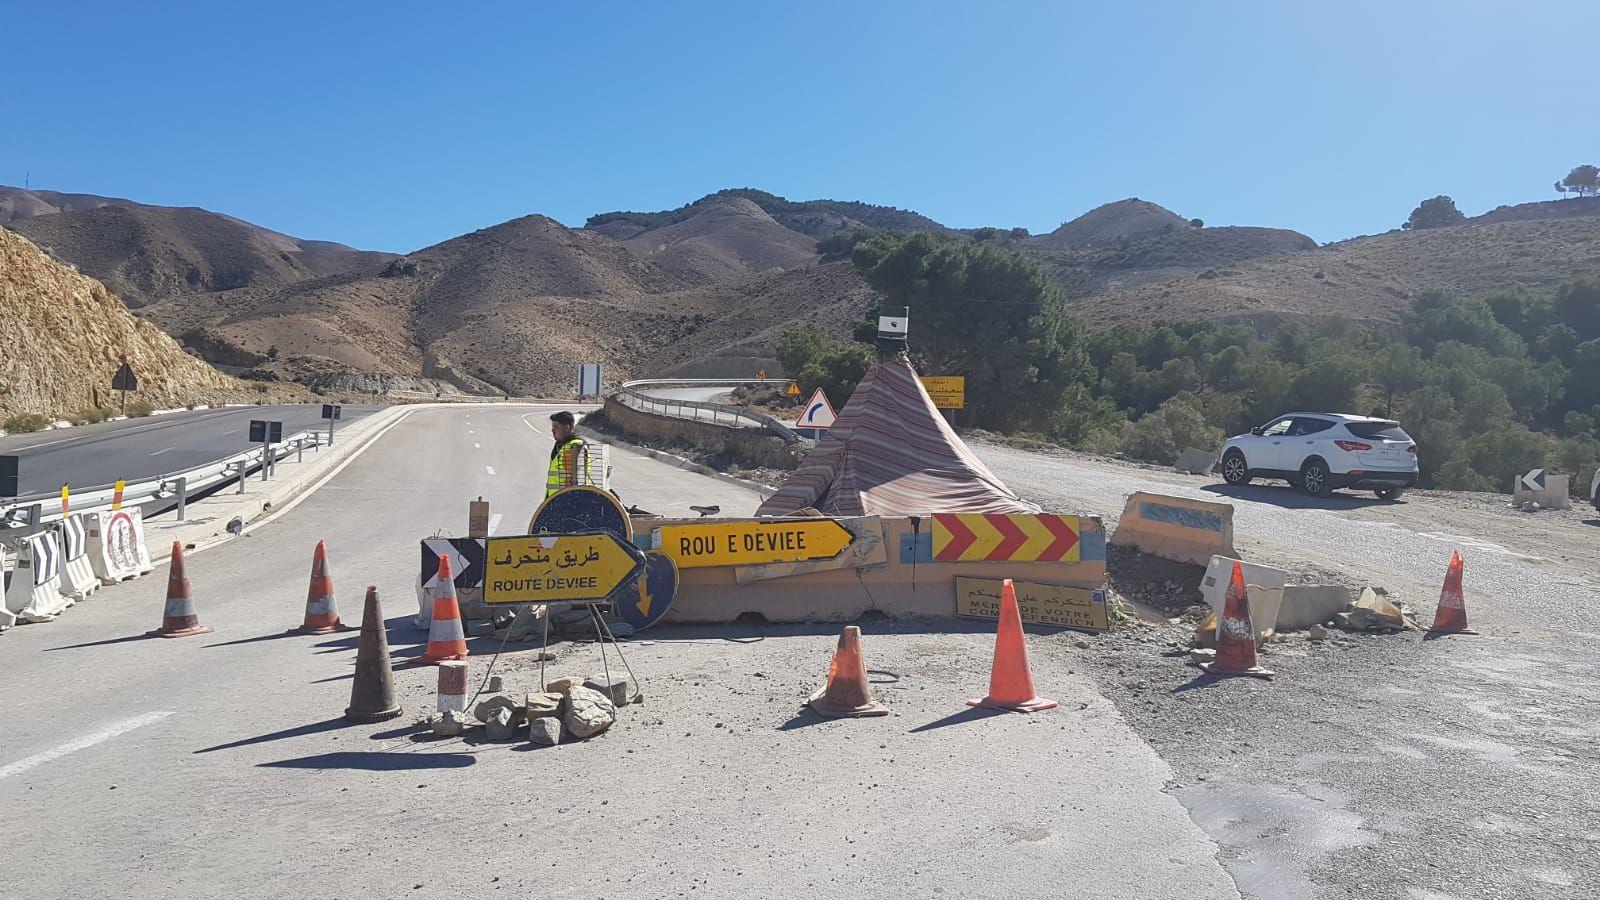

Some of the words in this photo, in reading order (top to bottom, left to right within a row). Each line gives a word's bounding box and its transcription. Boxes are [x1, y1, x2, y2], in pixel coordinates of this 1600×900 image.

[680, 535, 738, 556] ROUE
[494, 549, 550, 568] منحرف
[556, 546, 600, 568] طريق
[493, 579, 541, 592] ROUTE
[1021, 605, 1039, 614] DE
[1044, 608, 1091, 619] VOTRE
